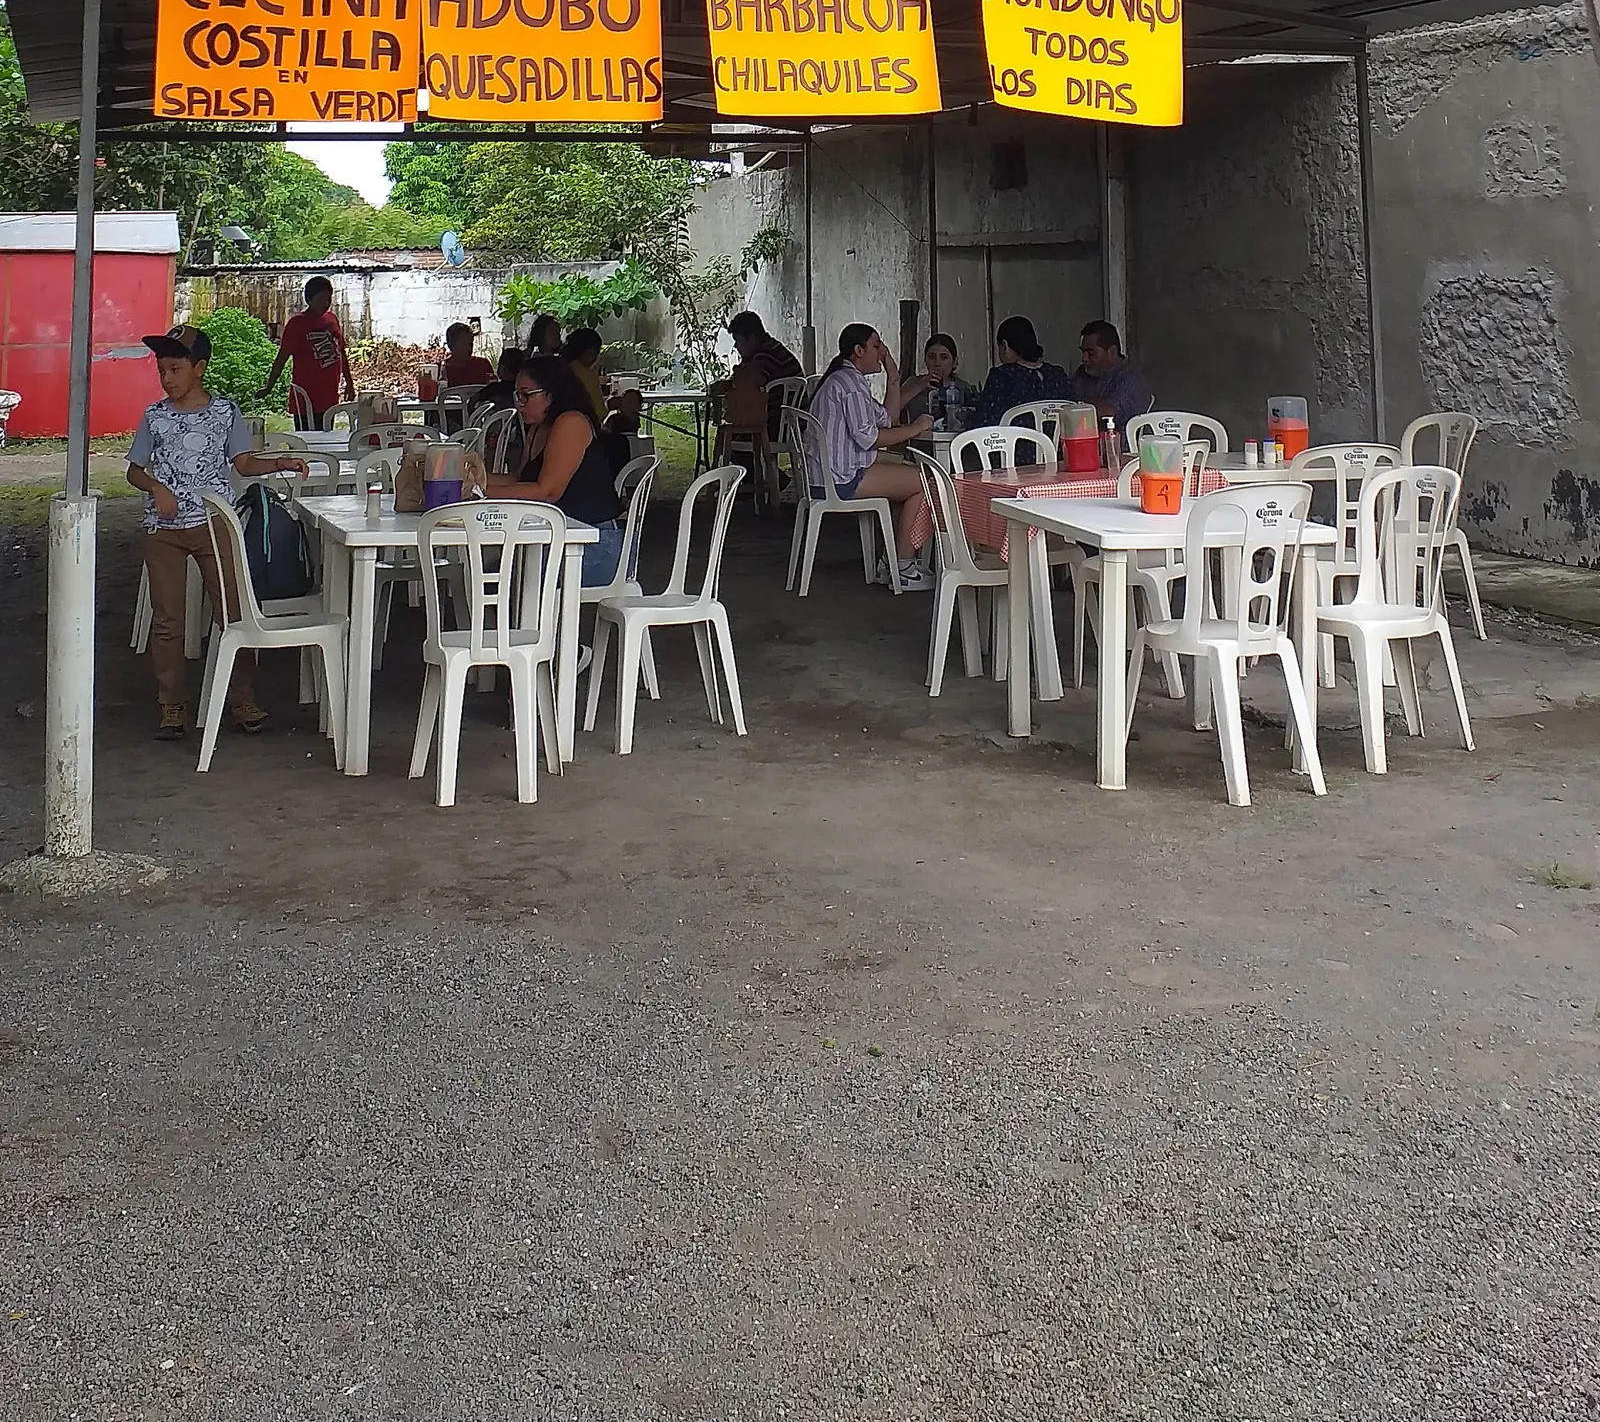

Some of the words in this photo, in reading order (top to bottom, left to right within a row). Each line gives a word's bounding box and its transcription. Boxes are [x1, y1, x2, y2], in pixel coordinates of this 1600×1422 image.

[184, 20, 402, 72] COSTILLA
[1024, 26, 1129, 67] TODOS
[277, 69, 308, 84] EN
[426, 52, 663, 103] QUESADILLAS
[714, 55, 919, 95] CHILAQUILES
[990, 64, 1037, 98] LOS
[1066, 77, 1138, 115] DIAS
[161, 83, 275, 117] SALSA
[309, 87, 417, 123] VERDE
[1156, 482, 1170, 508] 4
[1255, 508, 1283, 519] Corona
[475, 511, 509, 523] Corona
